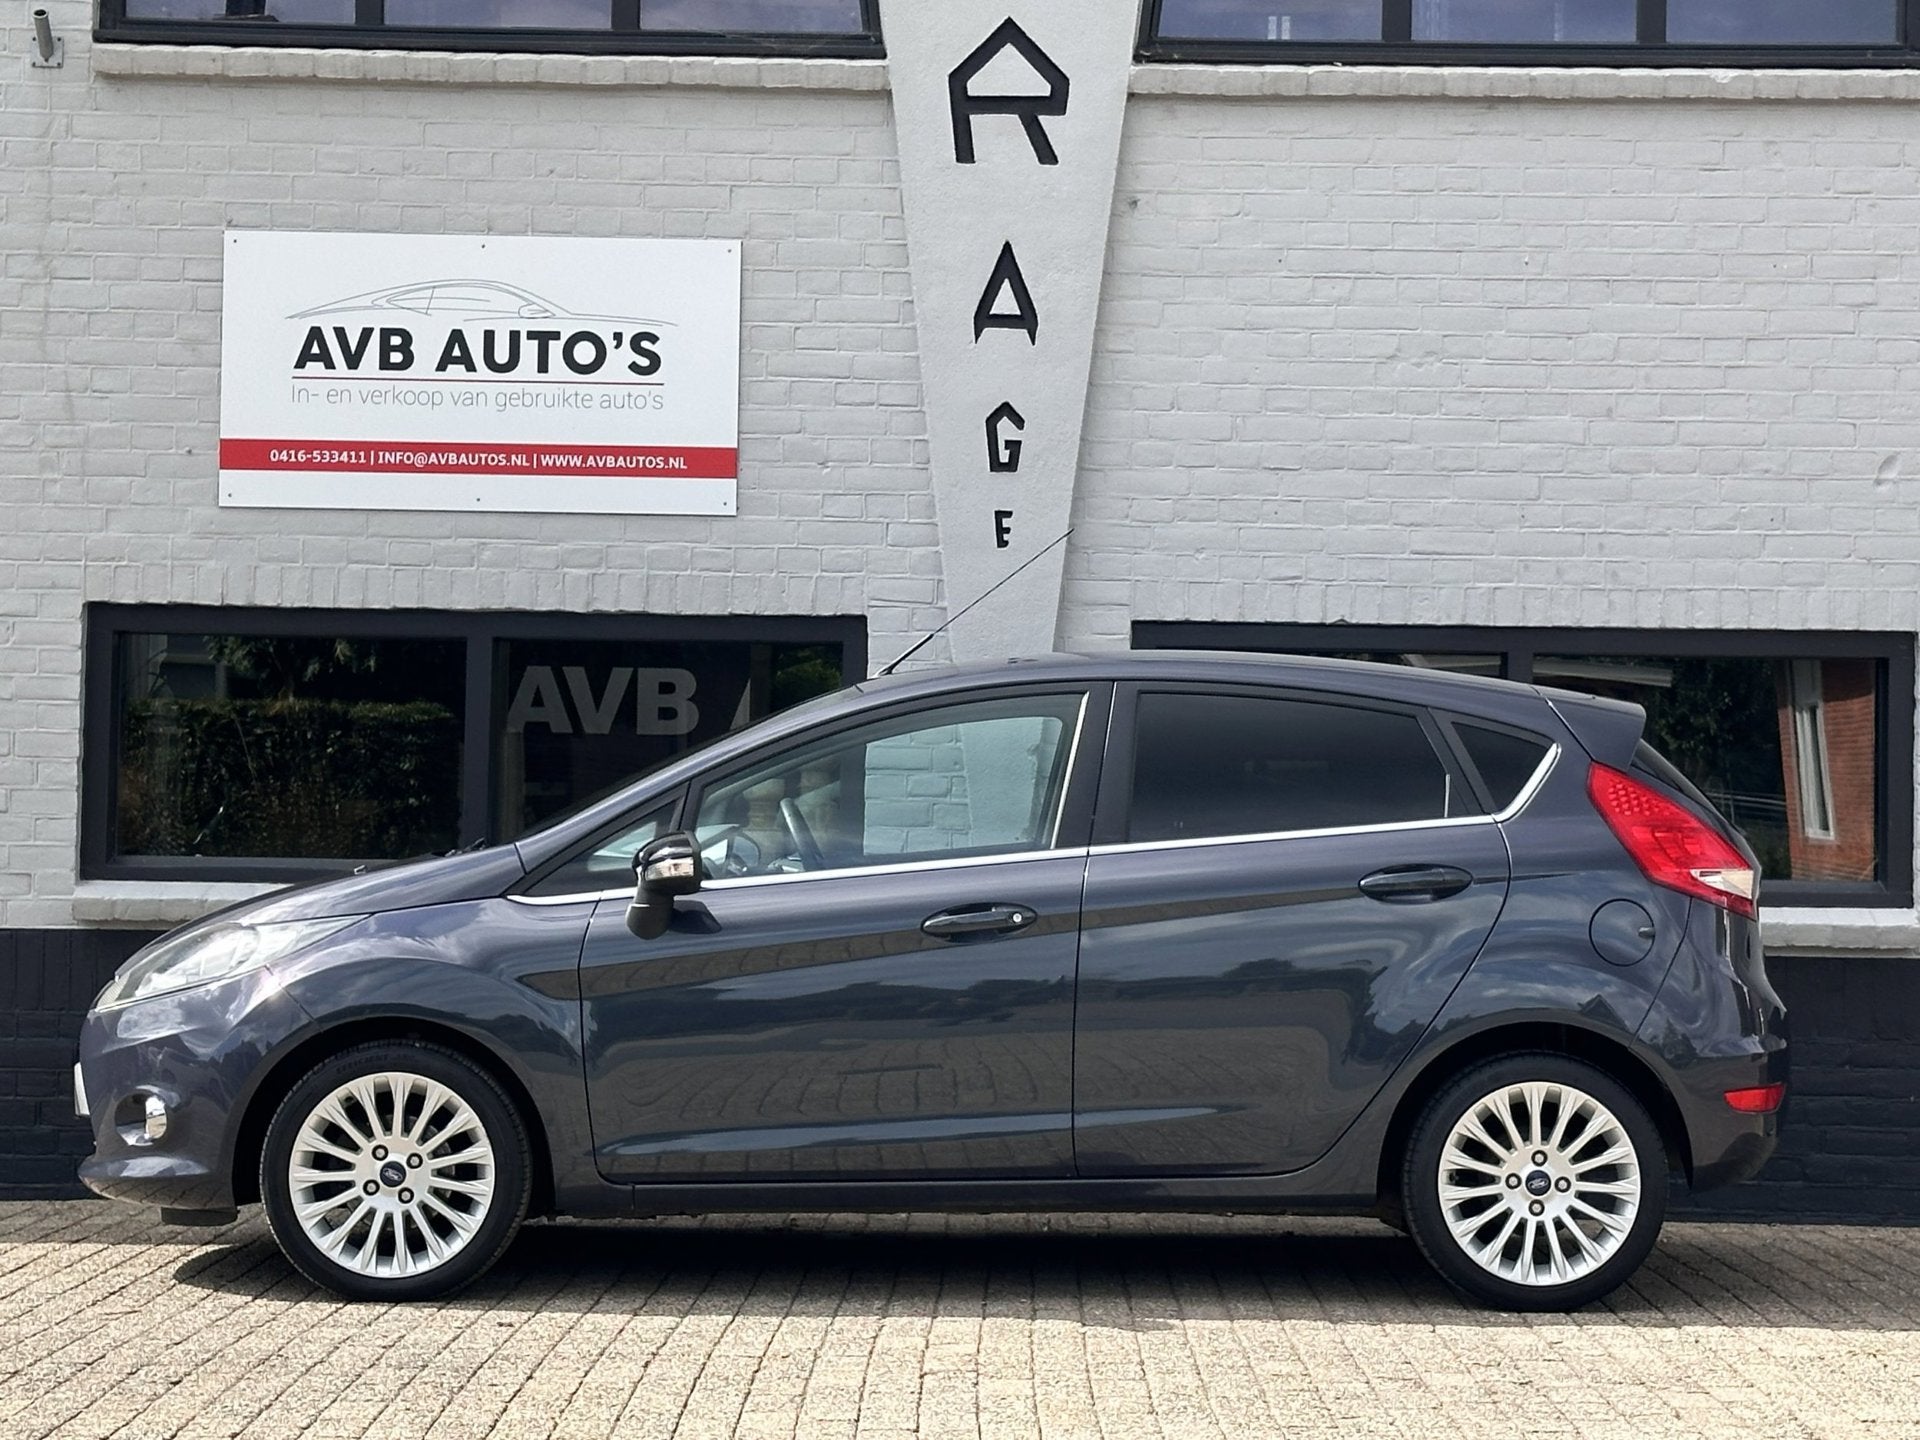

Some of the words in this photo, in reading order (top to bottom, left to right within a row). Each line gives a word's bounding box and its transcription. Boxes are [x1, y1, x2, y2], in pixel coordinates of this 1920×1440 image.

[293, 325, 415, 371] AVB
[291, 384, 319, 404] In-
[326, 387, 351, 405] en
[358, 384, 444, 410] verkoop
[450, 389, 488, 407] van
[495, 387, 594, 412] gebruikte
[599, 390, 664, 411] auto's
[269, 449, 366, 464] 0416-533411
[377, 451, 530, 468] INFO@AVBAUTOS.NL
[540, 453, 688, 470] WWW.AVBAUTOS.NL
[504, 665, 699, 736] AVB
